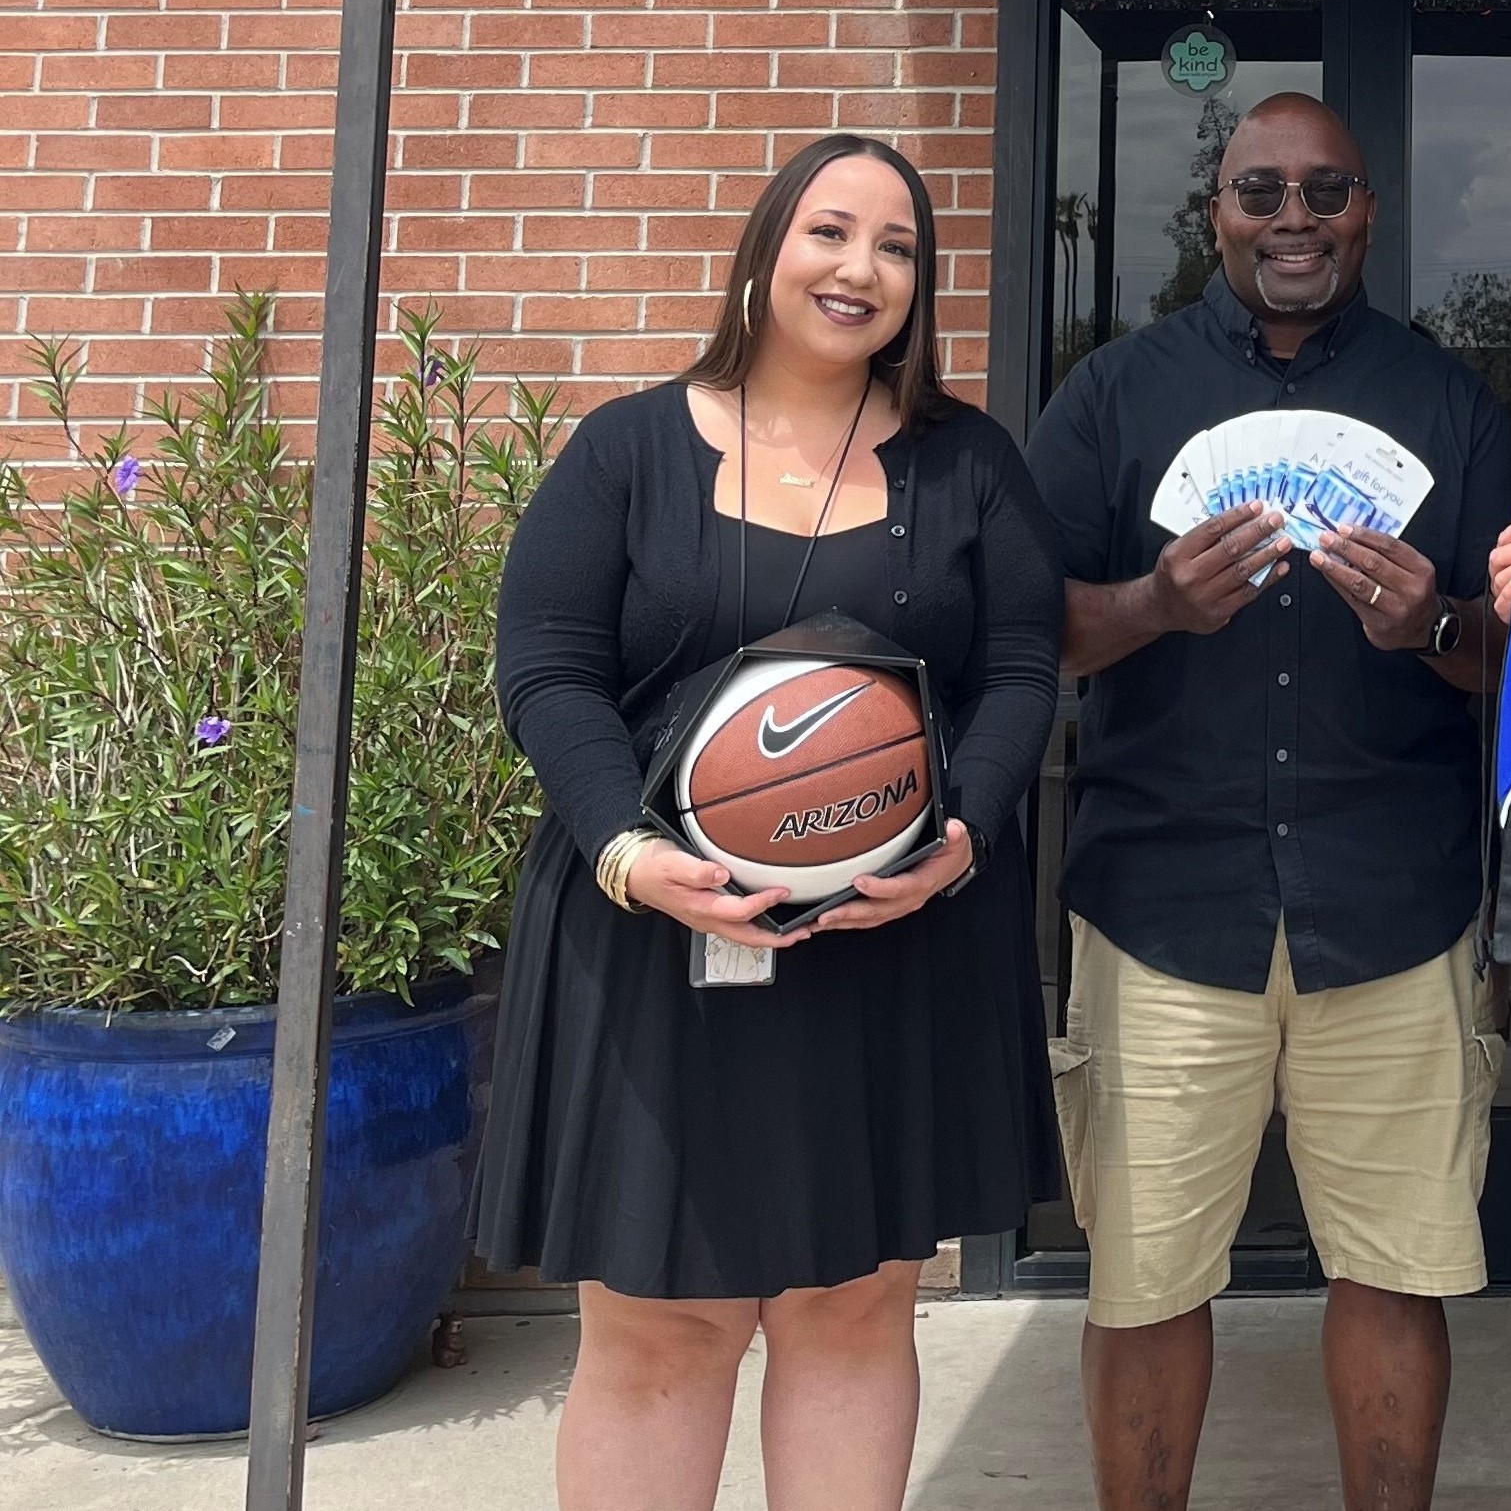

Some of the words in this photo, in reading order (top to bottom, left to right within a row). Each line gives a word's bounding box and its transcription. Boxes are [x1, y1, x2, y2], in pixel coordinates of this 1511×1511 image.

[1179, 57, 1218, 72] kind
[1188, 43, 1209, 56] be
[1343, 460, 1353, 472] A
[1352, 469, 1370, 485] gift
[1370, 478, 1386, 493] for
[1384, 489, 1404, 506] you
[769, 768, 919, 843] ARIZONA
